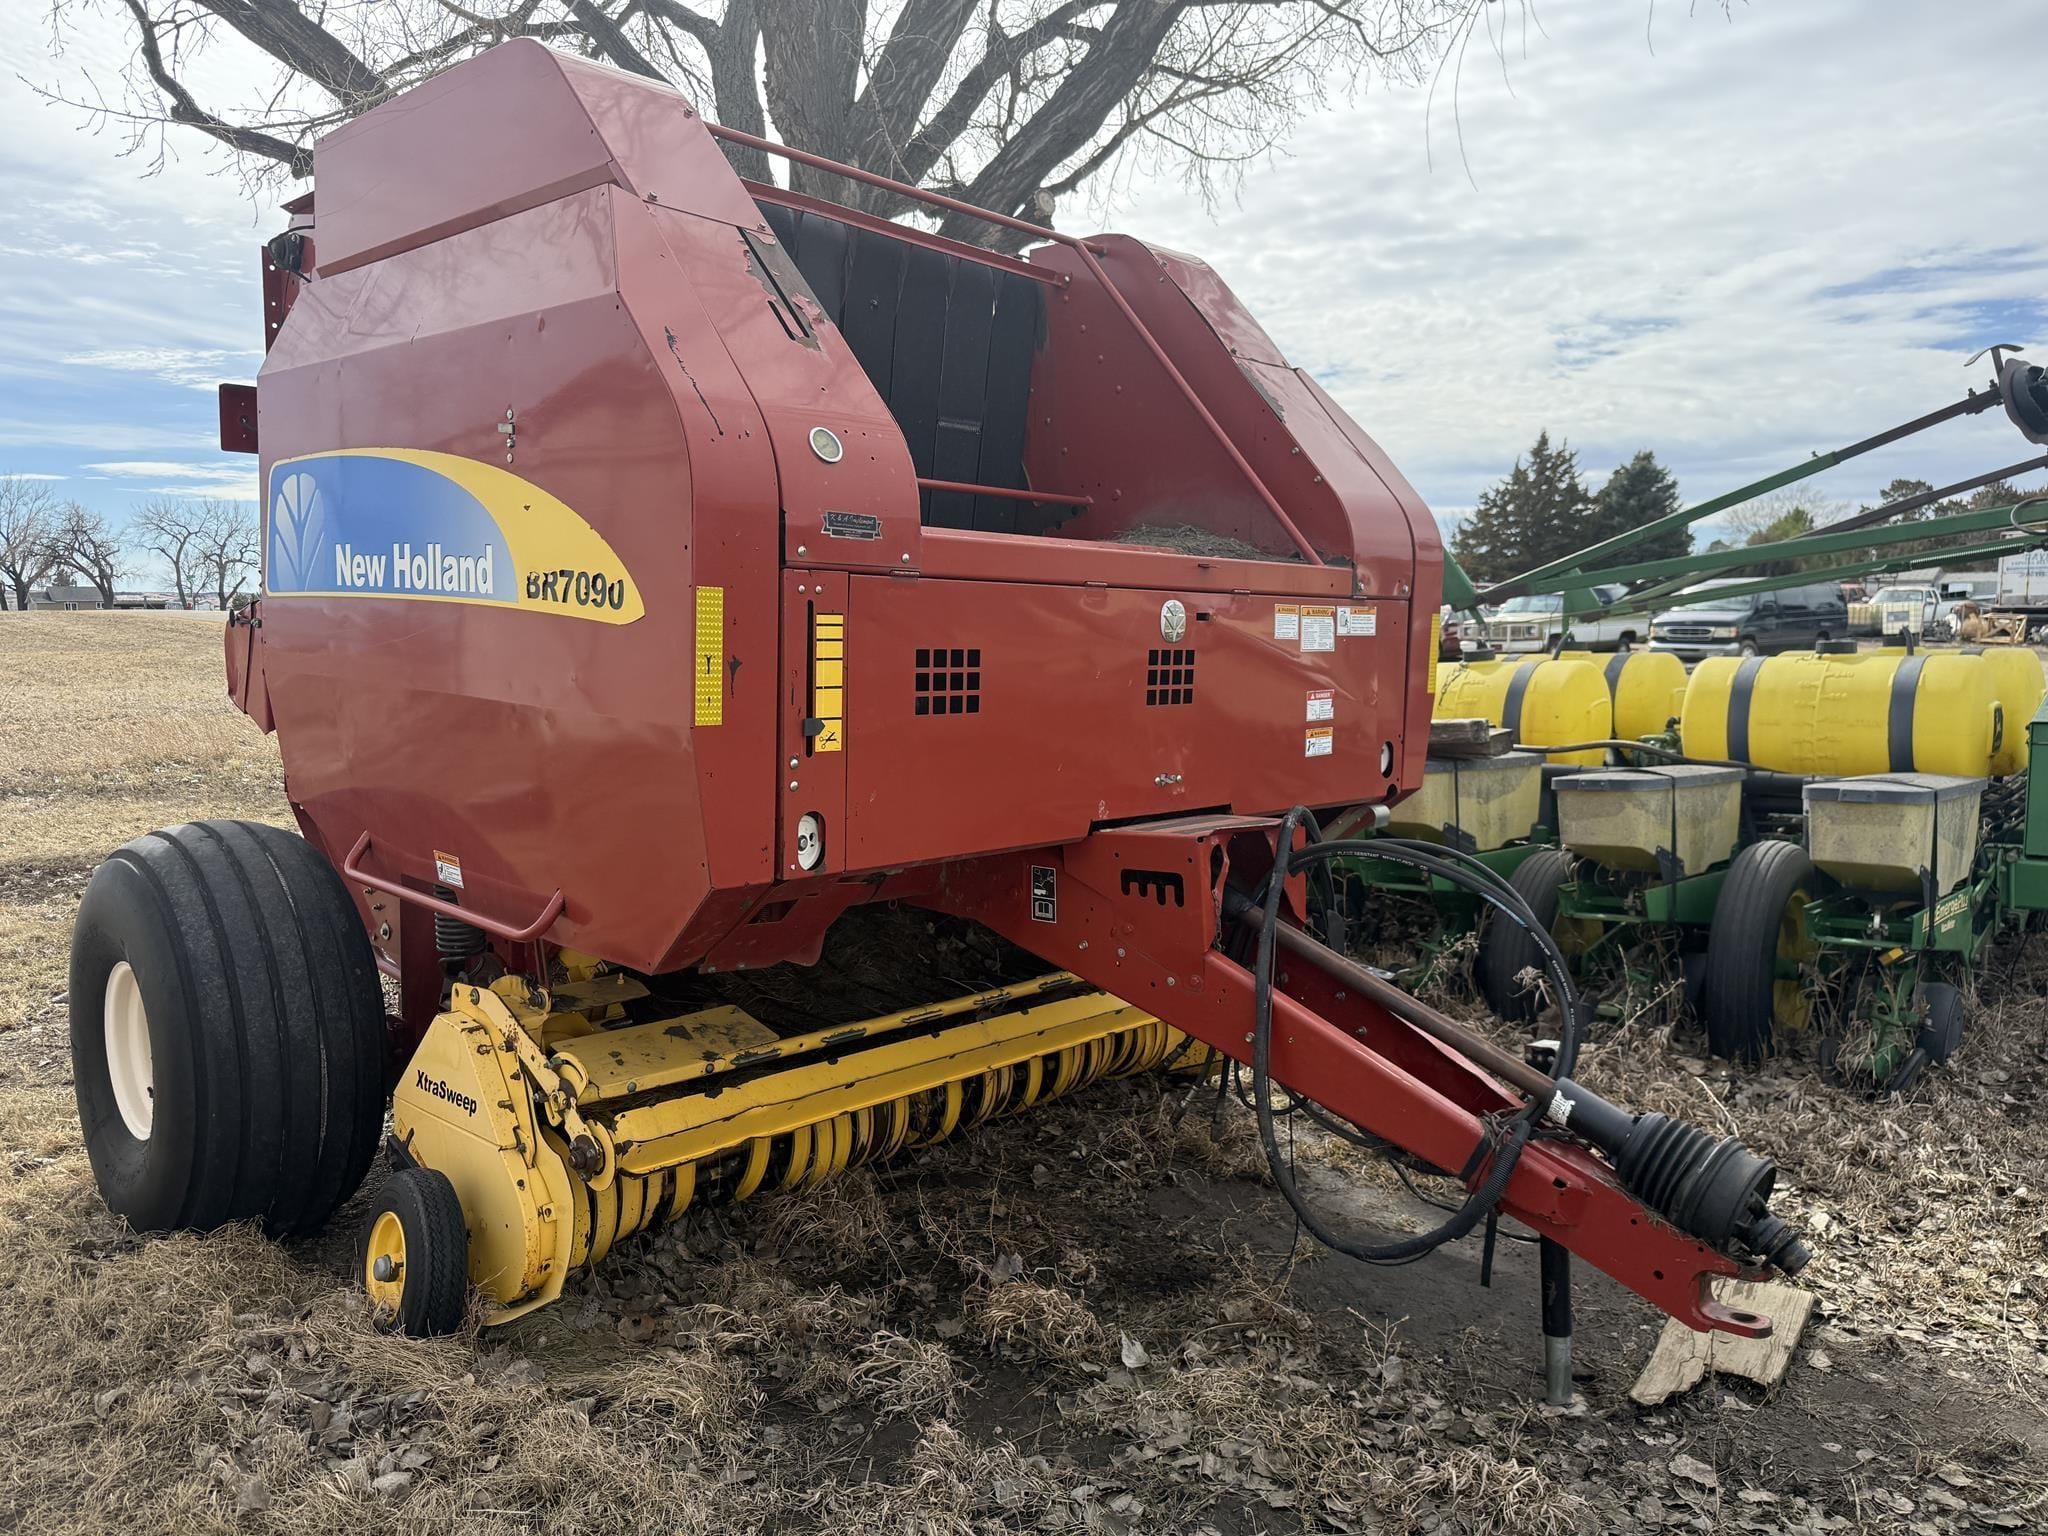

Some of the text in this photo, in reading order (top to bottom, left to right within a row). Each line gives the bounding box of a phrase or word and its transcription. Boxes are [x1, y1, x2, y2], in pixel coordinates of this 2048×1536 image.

[335, 543, 494, 595] New Holland
[526, 569, 625, 610] BR7090
[415, 1069, 478, 1118] XtraSweep
